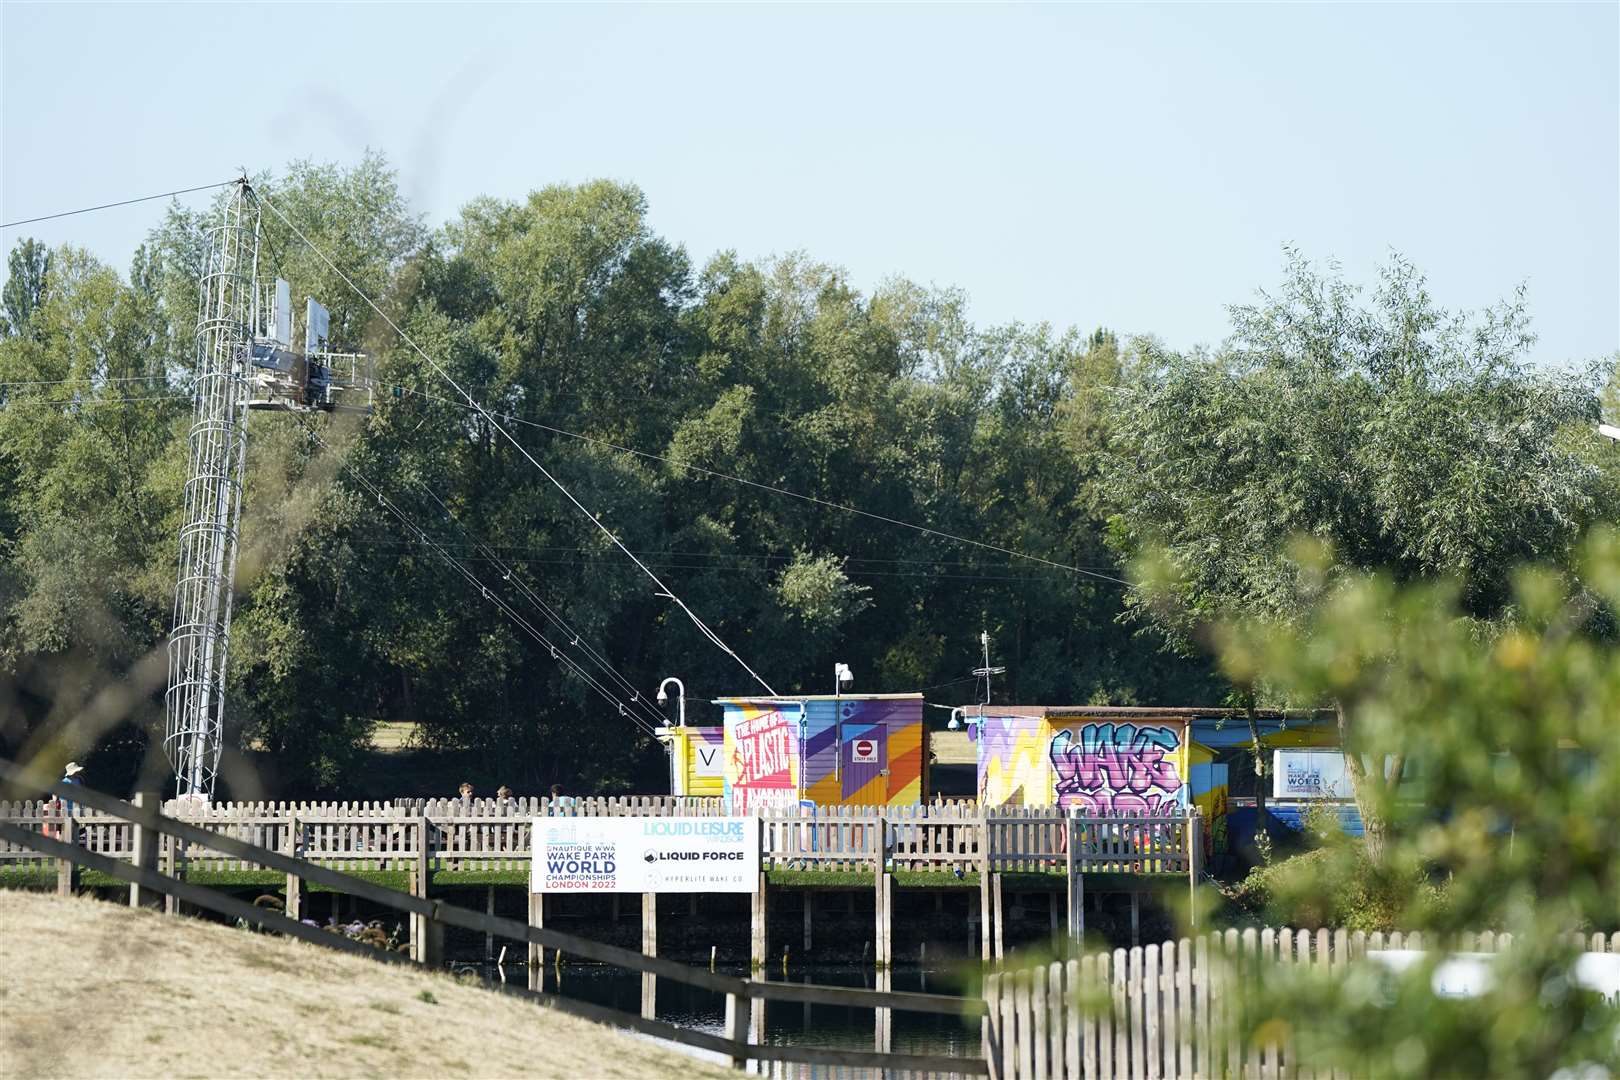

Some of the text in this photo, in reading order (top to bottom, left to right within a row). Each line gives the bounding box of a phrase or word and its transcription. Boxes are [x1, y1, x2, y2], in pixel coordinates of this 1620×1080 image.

[699, 748, 716, 766] V
[743, 725, 789, 783] PLASTIC
[1050, 723, 1181, 793] WAKE
[644, 822, 744, 836] LIQUID LEISURE
[547, 852, 616, 860] WAKE PARK
[659, 852, 744, 861] LIQUID FORCE
[547, 861, 616, 874] WORLD
[545, 881, 616, 889] LONDON 2022
